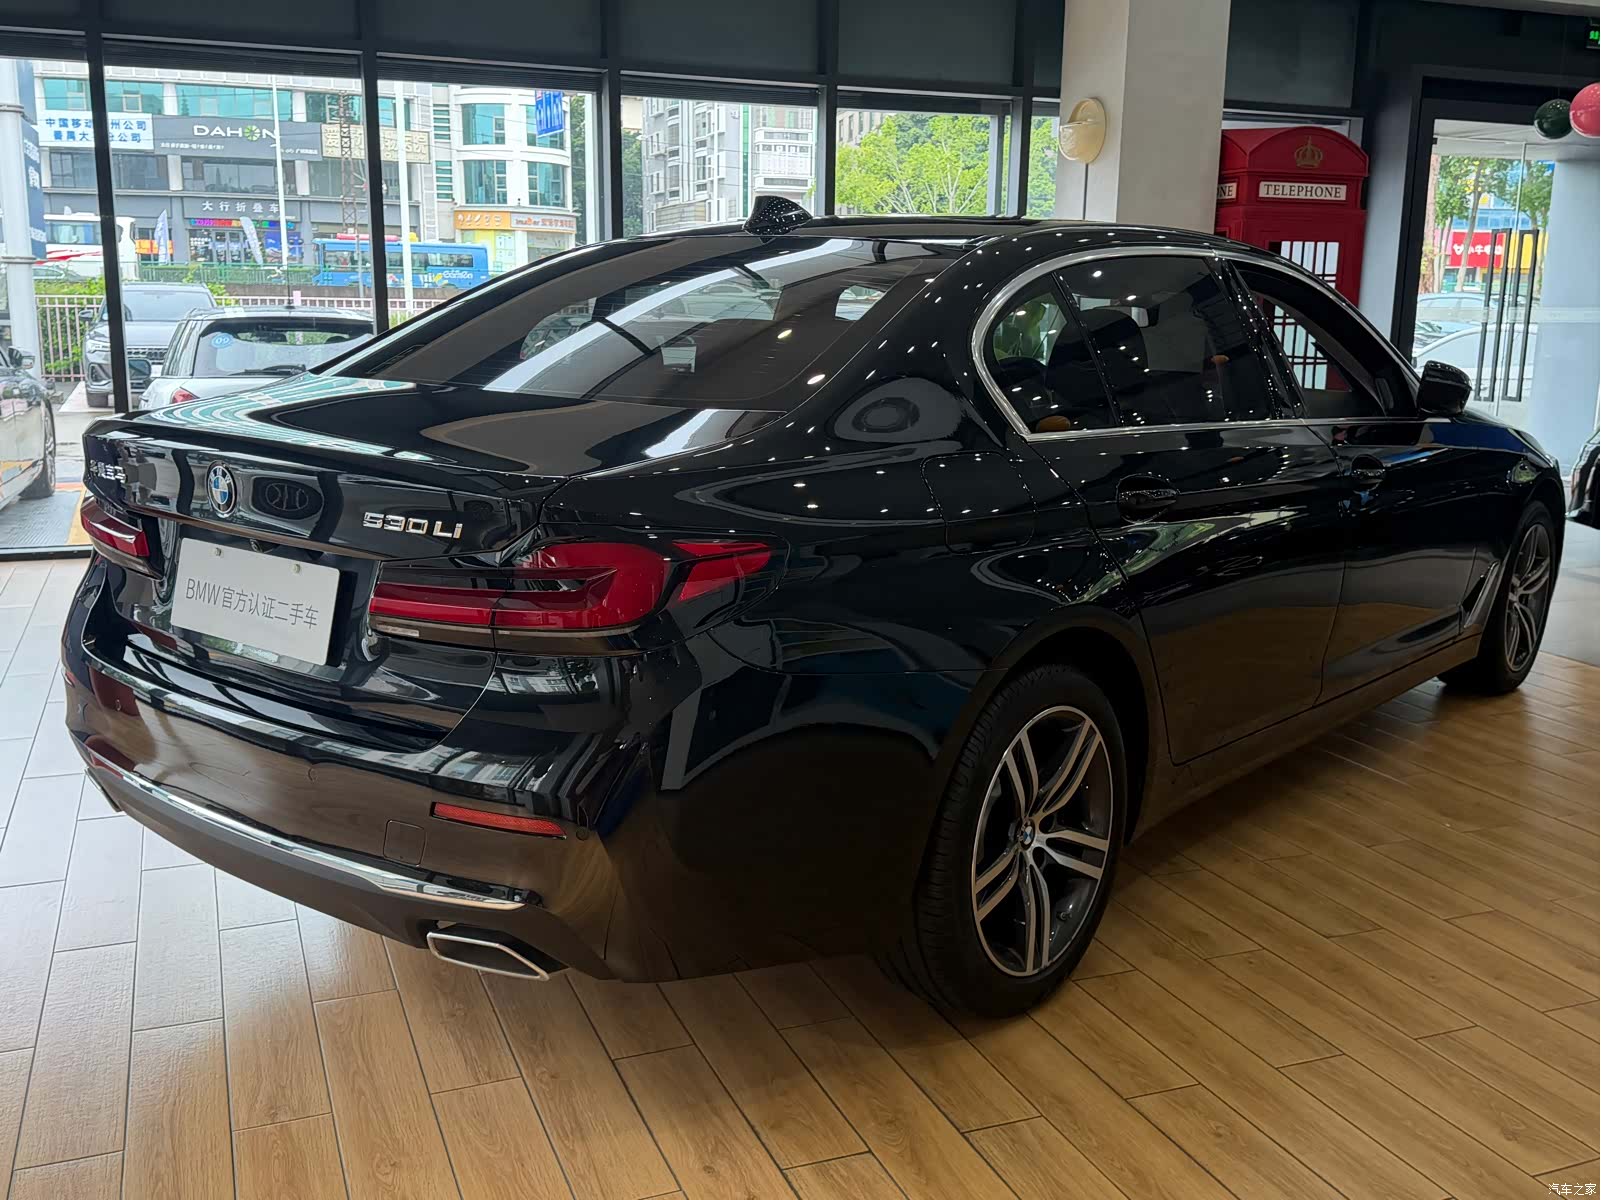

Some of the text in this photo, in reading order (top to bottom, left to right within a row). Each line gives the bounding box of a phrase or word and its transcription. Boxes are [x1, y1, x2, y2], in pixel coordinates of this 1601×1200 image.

[1263, 184, 1342, 198] TELEPHONE
[201, 200, 280, 213] 大行折叠车
